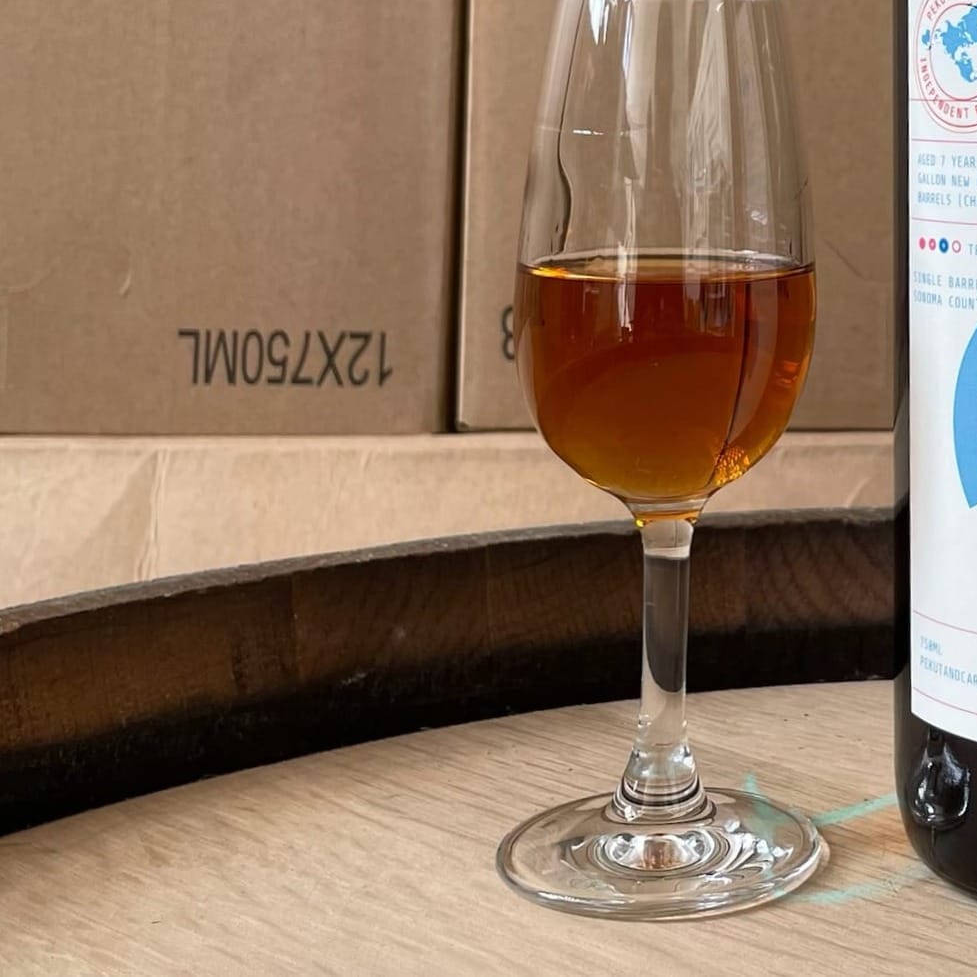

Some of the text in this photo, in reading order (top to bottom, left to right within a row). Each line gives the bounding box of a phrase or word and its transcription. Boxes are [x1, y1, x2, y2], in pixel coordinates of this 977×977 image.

[920, 57, 969, 119] INDEPENDENT
[918, 153, 936, 166] AGED
[940, 155, 946, 167] 7
[918, 173, 946, 186] GALLON
[951, 175, 970, 187] NEW
[918, 191, 951, 206] BARRELS
[912, 270, 942, 287] SINGLE
[912, 289, 943, 307] SONOMA
[177, 328, 395, 389] 12X750ML
